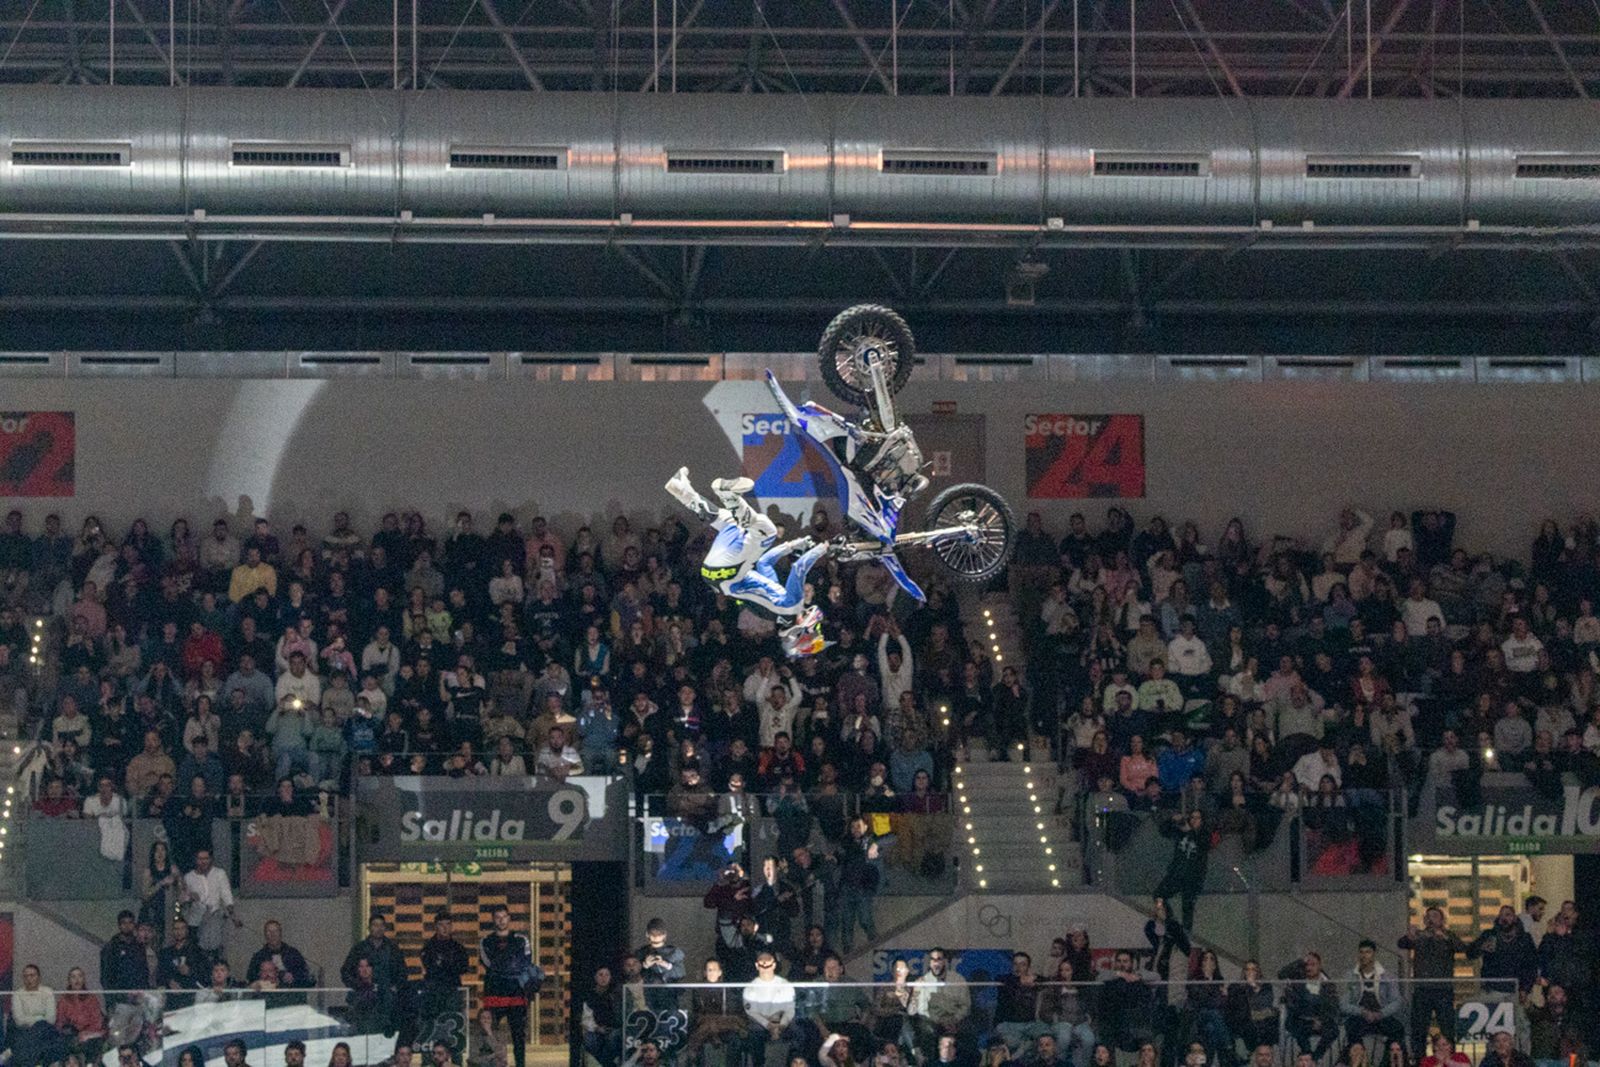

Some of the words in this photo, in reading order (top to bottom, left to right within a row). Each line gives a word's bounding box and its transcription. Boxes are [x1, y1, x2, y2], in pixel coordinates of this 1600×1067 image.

[1024, 415, 1101, 436] Sector
[1025, 414, 1145, 498] 24
[400, 809, 526, 841] Salida
[548, 789, 587, 841] 9
[1436, 804, 1557, 836] Salida
[627, 1008, 689, 1054] 23
[1459, 1002, 1516, 1039] 24
